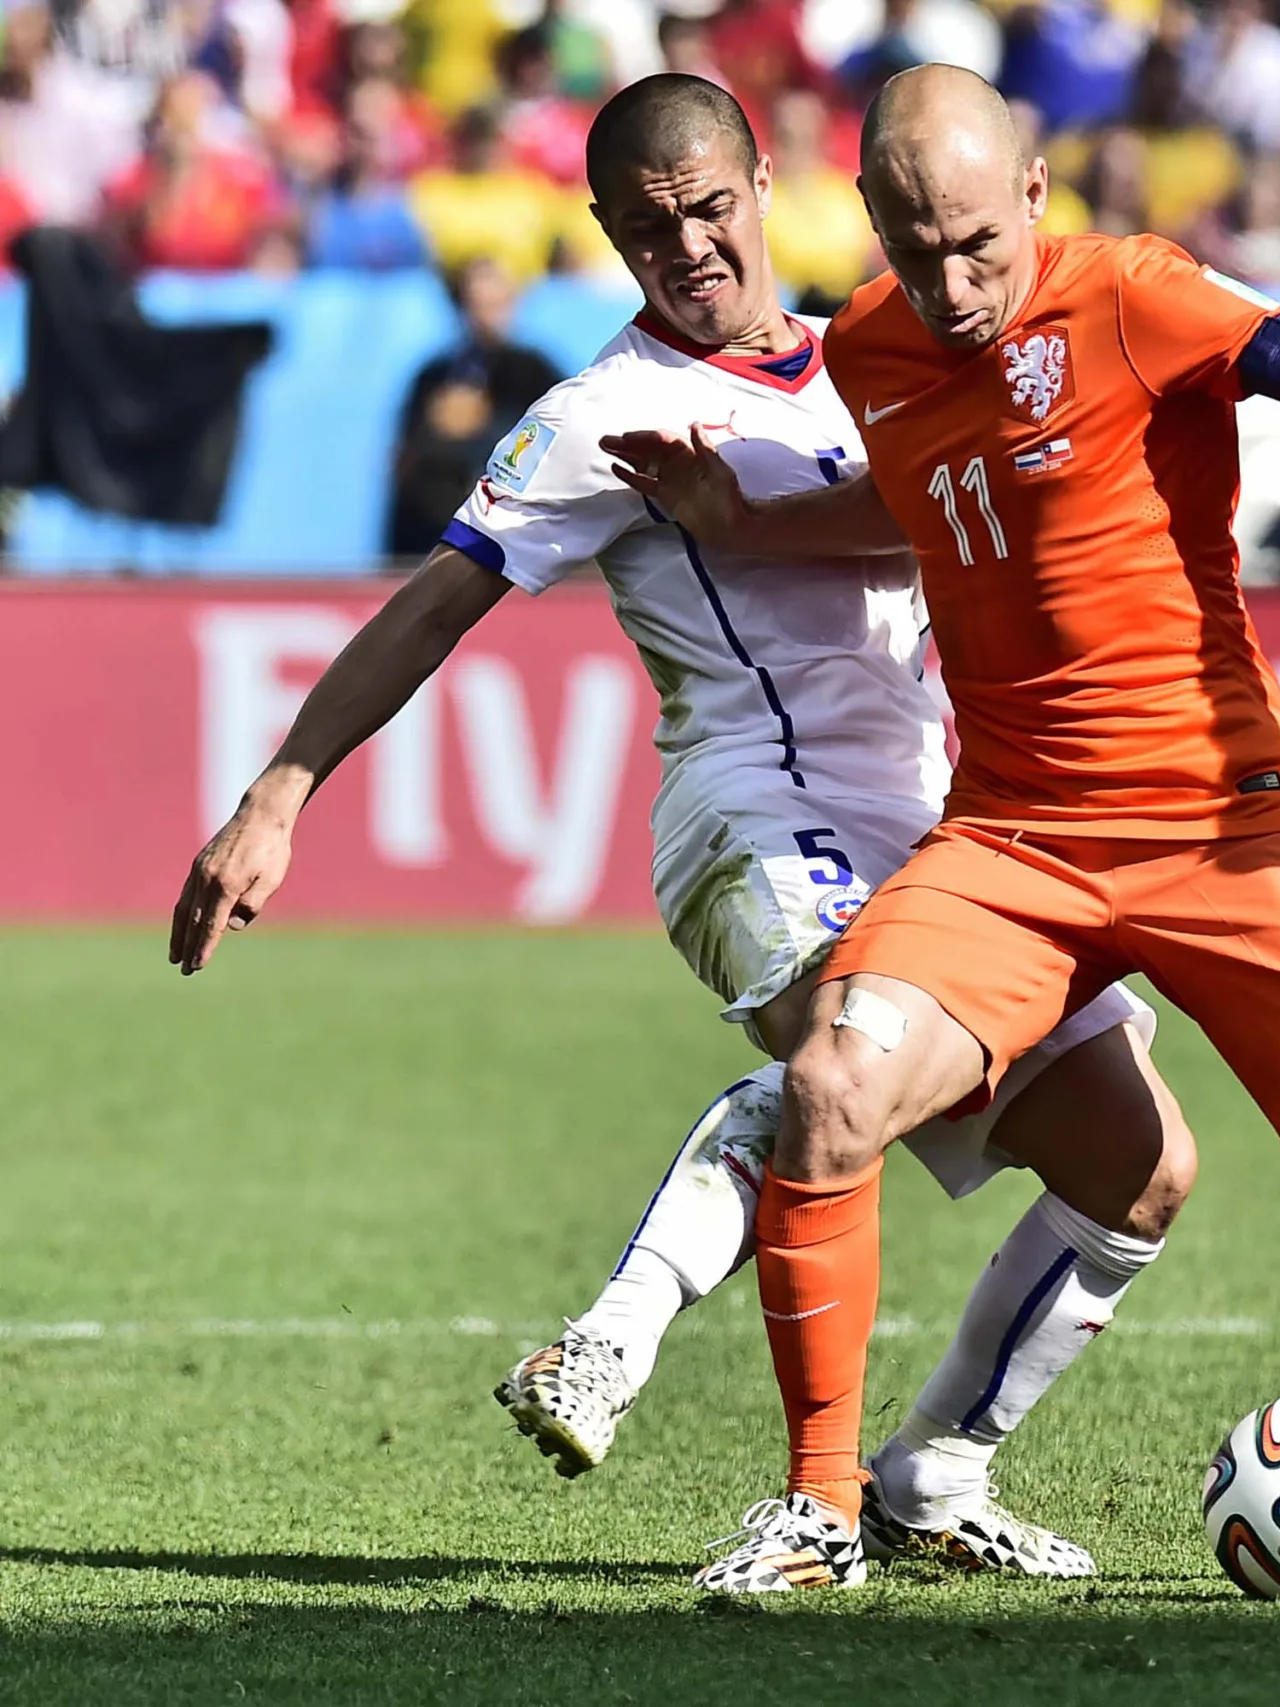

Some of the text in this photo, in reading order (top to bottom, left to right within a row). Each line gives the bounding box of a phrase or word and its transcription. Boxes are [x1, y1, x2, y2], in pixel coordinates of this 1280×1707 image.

[927, 456, 1008, 566] 11
[194, 606, 636, 925] Fly
[792, 828, 854, 887] 5
